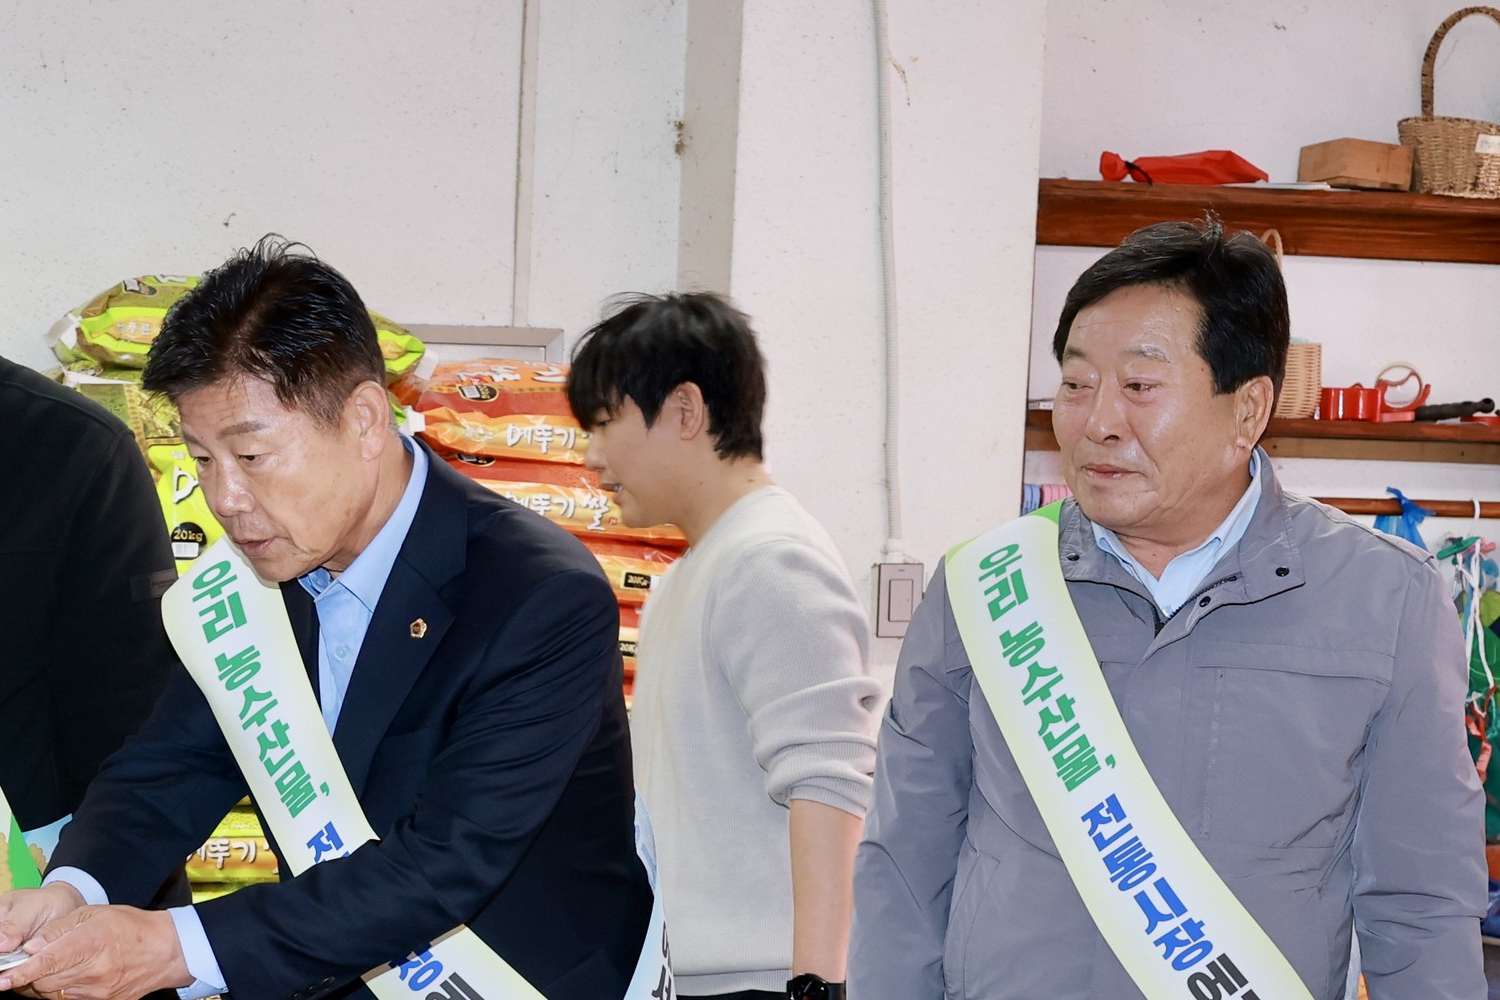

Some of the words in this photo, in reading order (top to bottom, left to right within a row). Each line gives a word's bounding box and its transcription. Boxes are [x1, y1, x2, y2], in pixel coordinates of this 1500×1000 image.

[173, 530, 203, 542] 20kg
[191, 559, 247, 643] 우리
[978, 542, 1030, 623] 우리
[214, 645, 331, 818] 농수산물,
[999, 621, 1117, 792] 농수산물,
